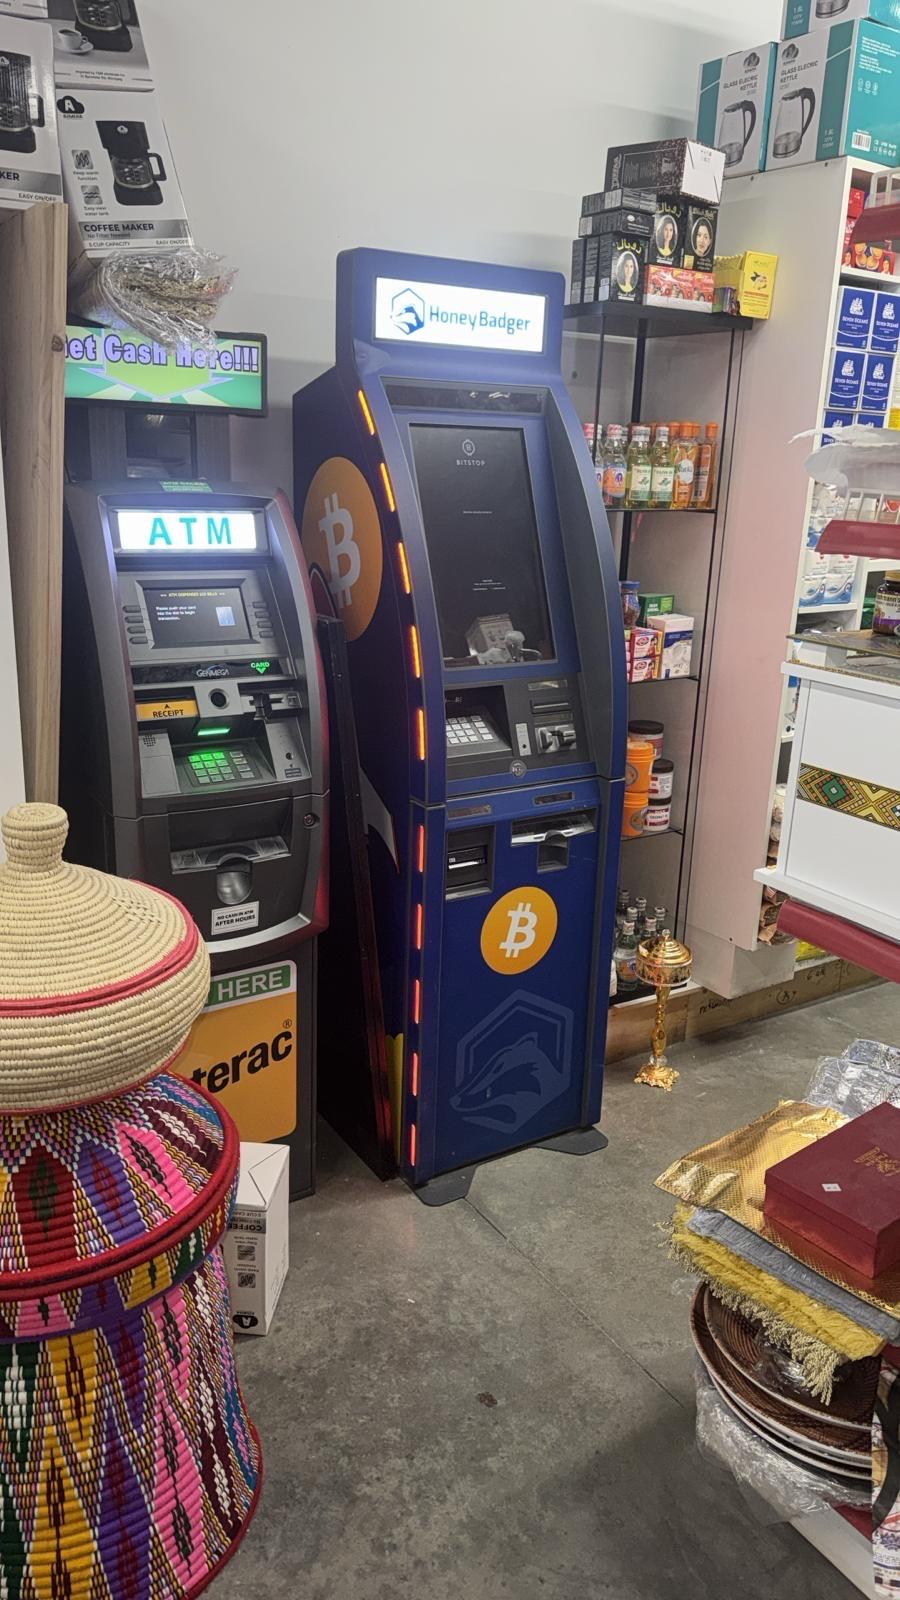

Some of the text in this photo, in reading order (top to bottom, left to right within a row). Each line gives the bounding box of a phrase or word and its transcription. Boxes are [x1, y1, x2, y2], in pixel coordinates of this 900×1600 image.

[0, 170, 20, 181] KER
[84, 223, 154, 232] COFFEE MAKER
[66, 334, 259, 373] et Cash Here!!!
[149, 517, 232, 545] ATM
[250, 661, 270, 669] CARD
[152, 708, 184, 718] RECEIPT
[215, 914, 256, 927] AFTER HOURS
[217, 969, 283, 1001] HERE
[190, 1030, 293, 1094] terac
[229, 1223, 262, 1232] COFFE
